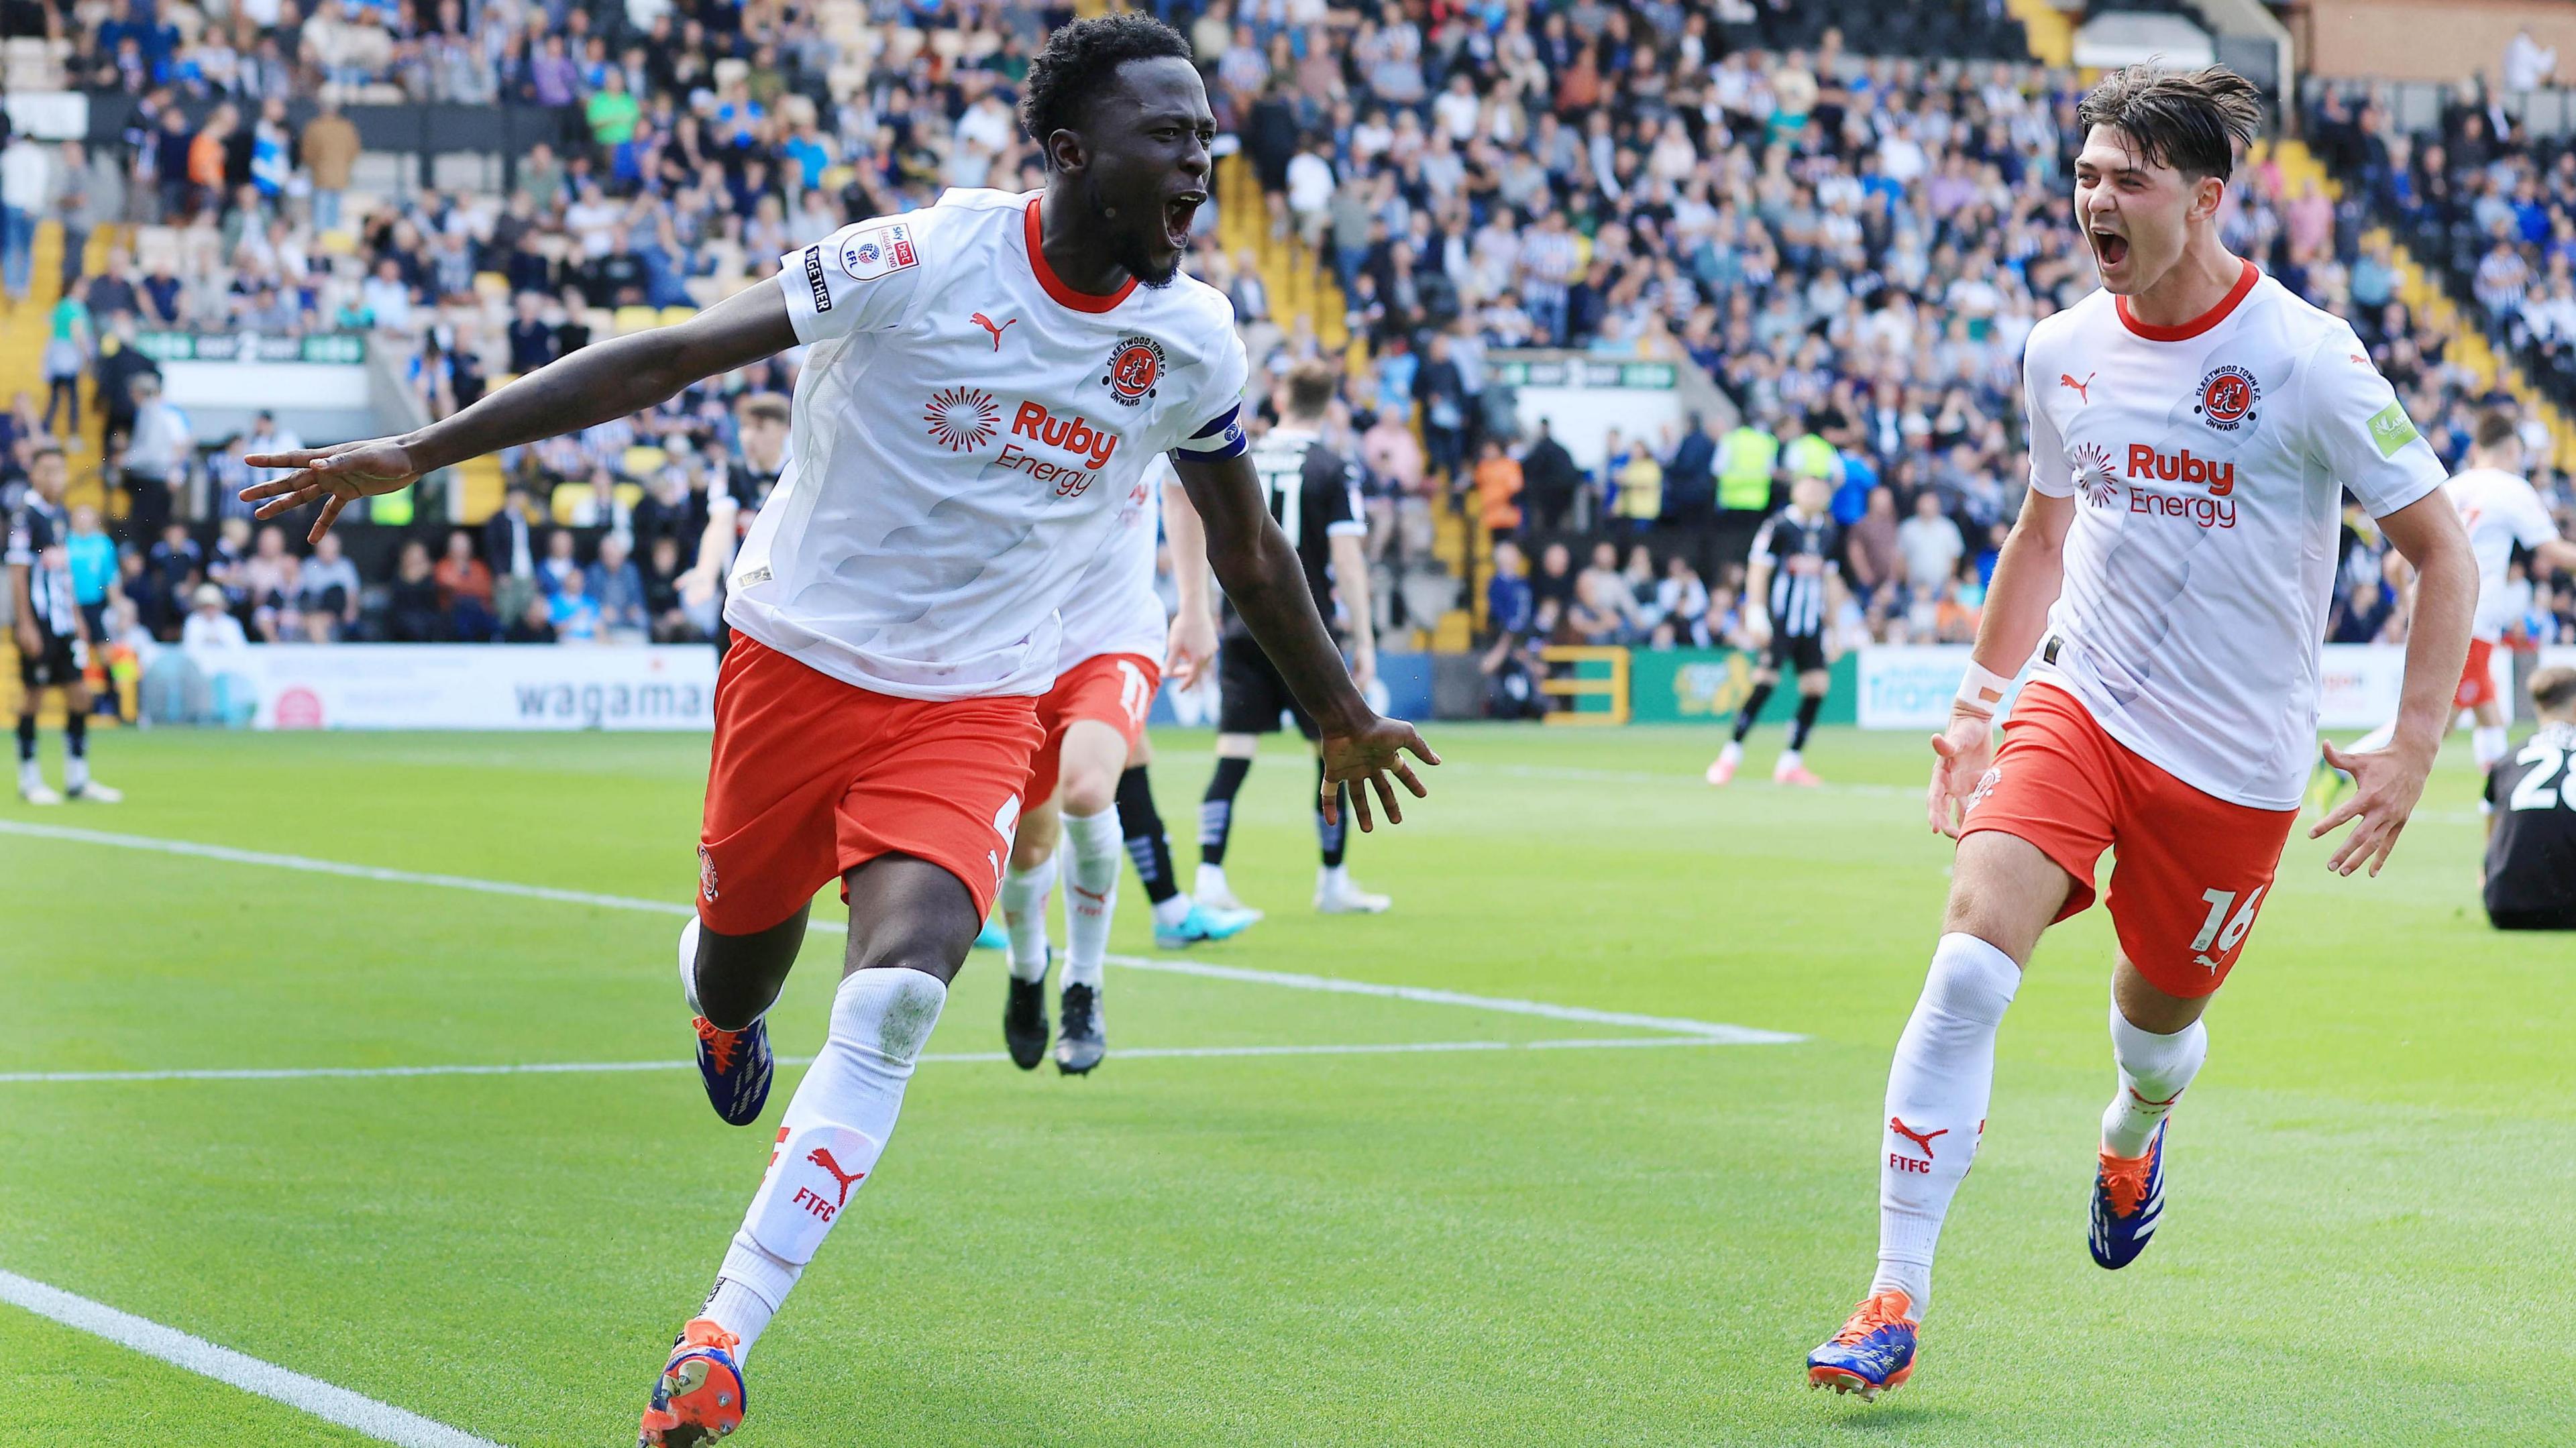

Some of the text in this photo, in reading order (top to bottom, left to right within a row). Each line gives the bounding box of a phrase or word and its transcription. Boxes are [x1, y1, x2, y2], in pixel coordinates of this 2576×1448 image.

[846, 251, 857, 268] EFL
[881, 229, 898, 268] LEAGUE TWO
[894, 227, 912, 263] sky bet
[1107, 337, 1150, 366] FLEETWOOD
[1150, 341, 1166, 362] TOWN
[2196, 365, 2237, 396] FLEETWOOD
[2239, 367, 2258, 387] TOWN
[1110, 392, 1140, 407] ONWARD
[1012, 400, 1117, 469] Ruby
[2206, 419, 2239, 431] ONWARD
[994, 443, 1097, 497] Energy
[2127, 443, 2234, 496] Ruby
[2129, 487, 2236, 528] Energy
[514, 681, 714, 727] wagama
[2190, 884, 2265, 952] 16
[1889, 1153, 1930, 1174] FTFC
[792, 1186, 836, 1223] FTFC
